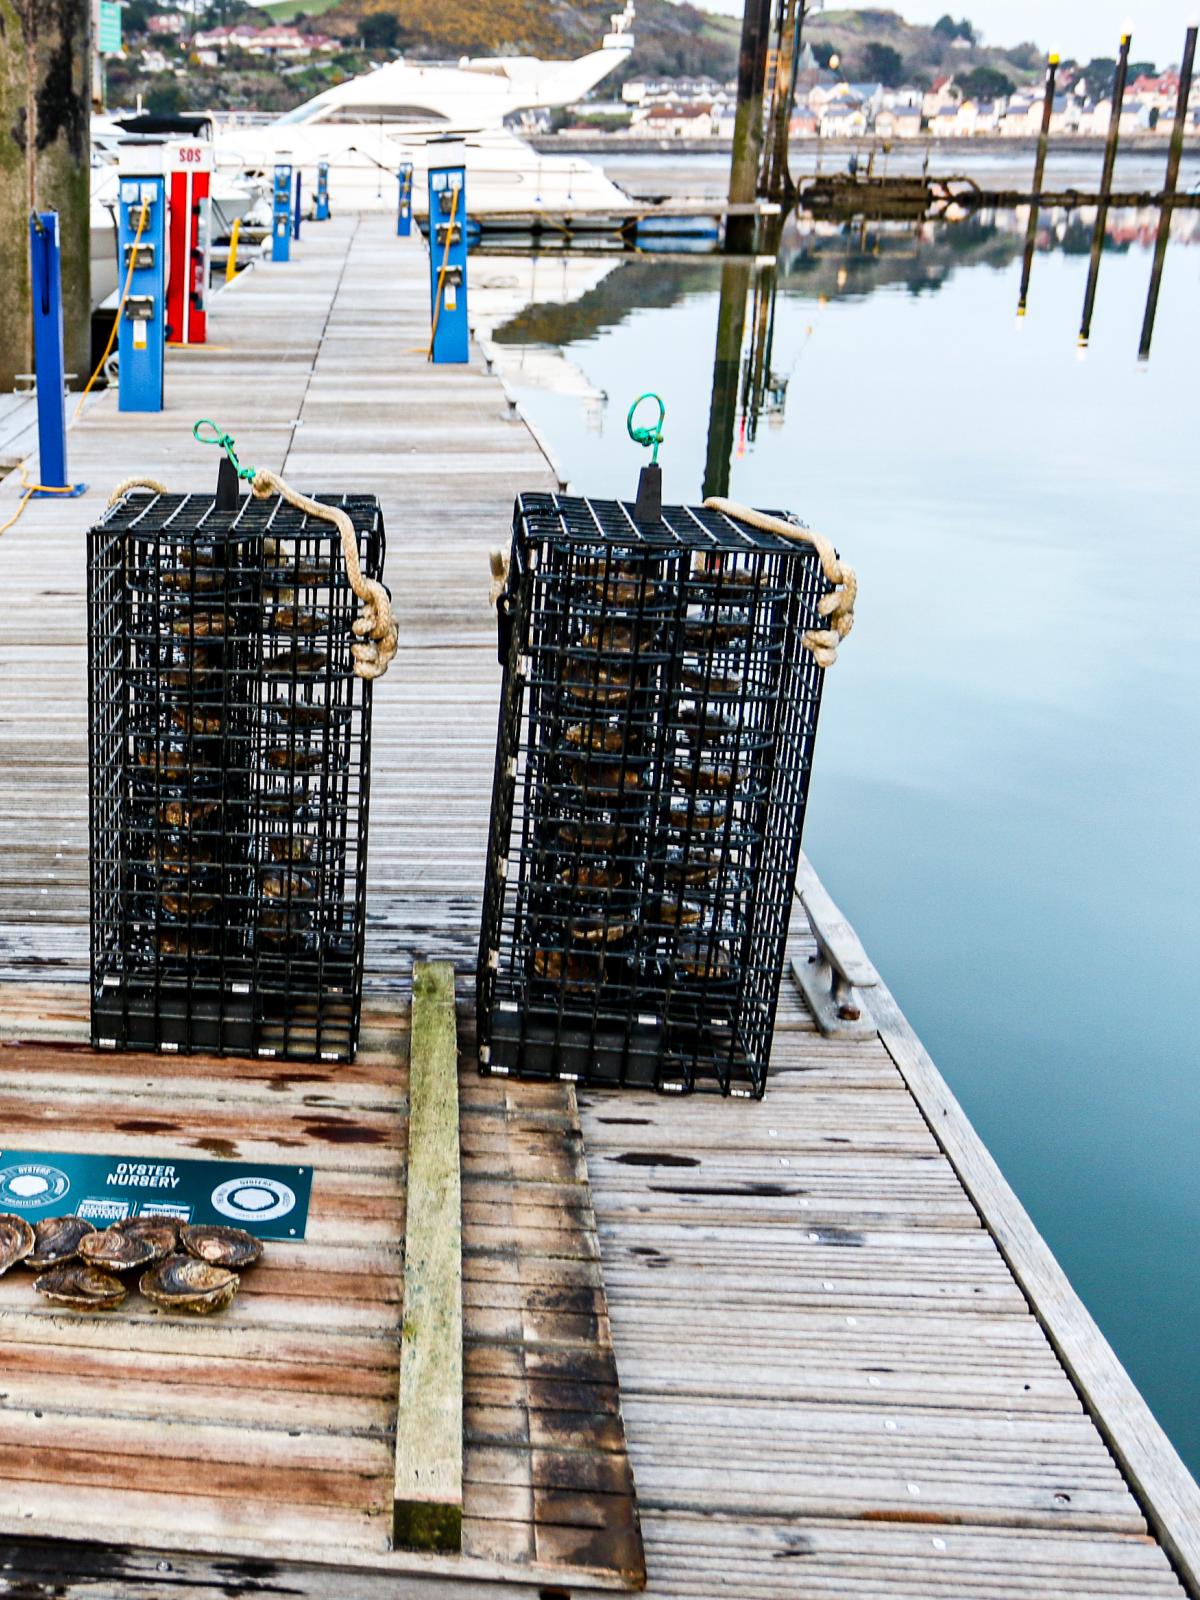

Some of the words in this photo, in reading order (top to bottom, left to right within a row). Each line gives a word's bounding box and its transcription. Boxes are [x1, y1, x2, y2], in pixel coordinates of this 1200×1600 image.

[179, 147, 201, 162] SOS
[116, 1163, 175, 1176] OYSTER
[106, 1173, 180, 1188] NURSERY
